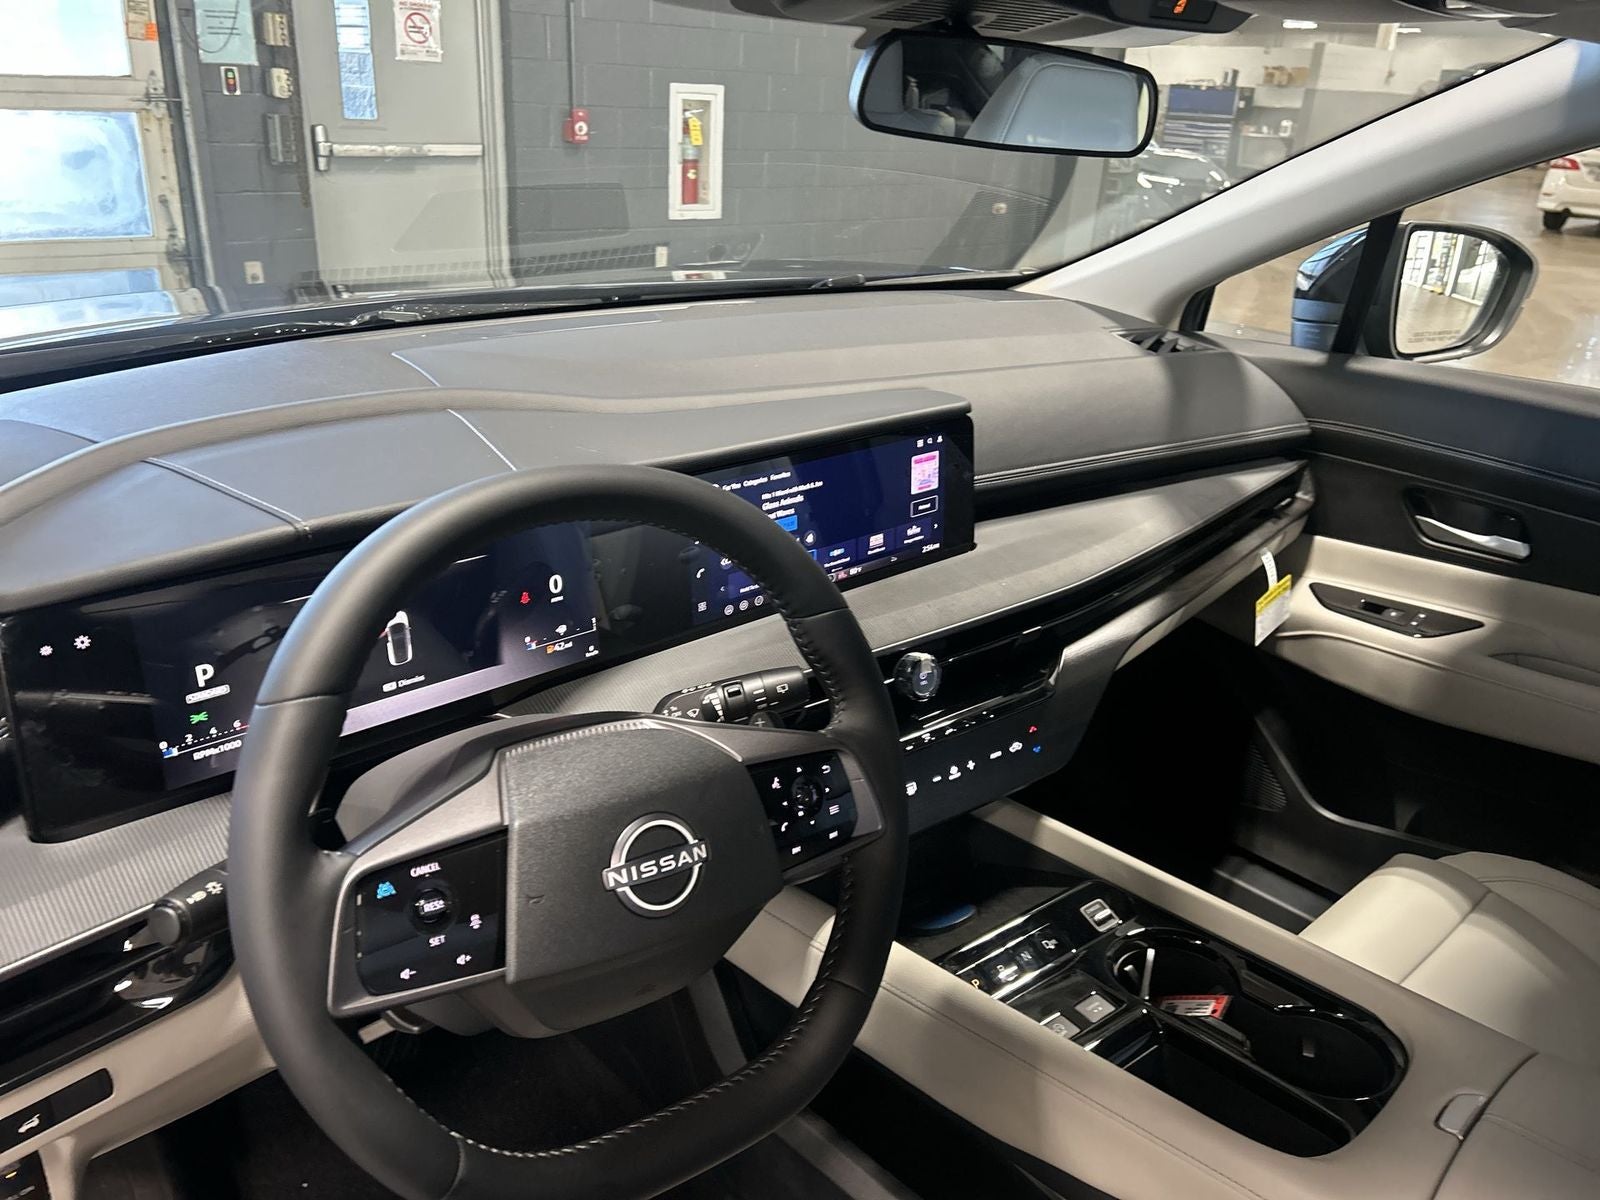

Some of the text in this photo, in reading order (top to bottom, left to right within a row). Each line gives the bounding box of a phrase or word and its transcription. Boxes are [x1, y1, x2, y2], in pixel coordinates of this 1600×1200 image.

[549, 574, 563, 594] 0
[195, 663, 215, 688] P
[185, 734, 193, 743] 2
[411, 862, 441, 877] CANCEL
[607, 844, 707, 888] NISSAN
[429, 935, 446, 947] SET
[971, 979, 980, 989] P
